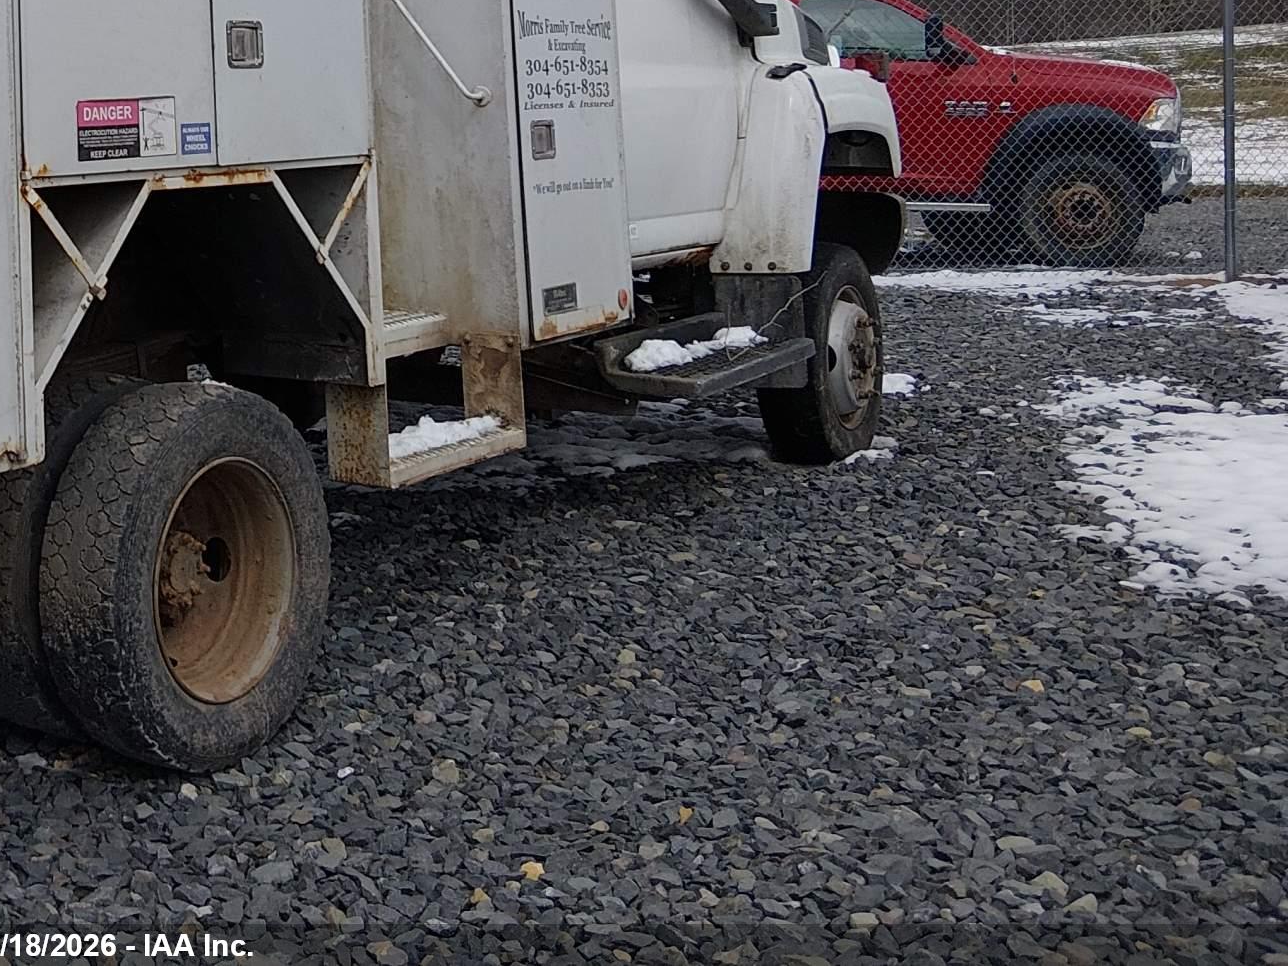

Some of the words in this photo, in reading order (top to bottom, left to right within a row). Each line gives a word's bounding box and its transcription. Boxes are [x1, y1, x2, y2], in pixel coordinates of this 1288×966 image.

[517, 9, 544, 40] Morris
[544, 18, 569, 36] Family
[569, 20, 586, 35] Tree
[586, 13, 611, 40] Service
[547, 38, 553, 51] &
[553, 38, 586, 54] Excavating
[525, 55, 609, 77] 304-651-8354
[526, 78, 610, 100] 304-651-8353
[567, 99, 575, 109] &
[579, 98, 615, 109] Insured
[83, 105, 132, 122] DANGER
[119, 127, 138, 135] HAZARD
[90, 150, 107, 159] KEEP
[107, 148, 128, 158] CLEAR
